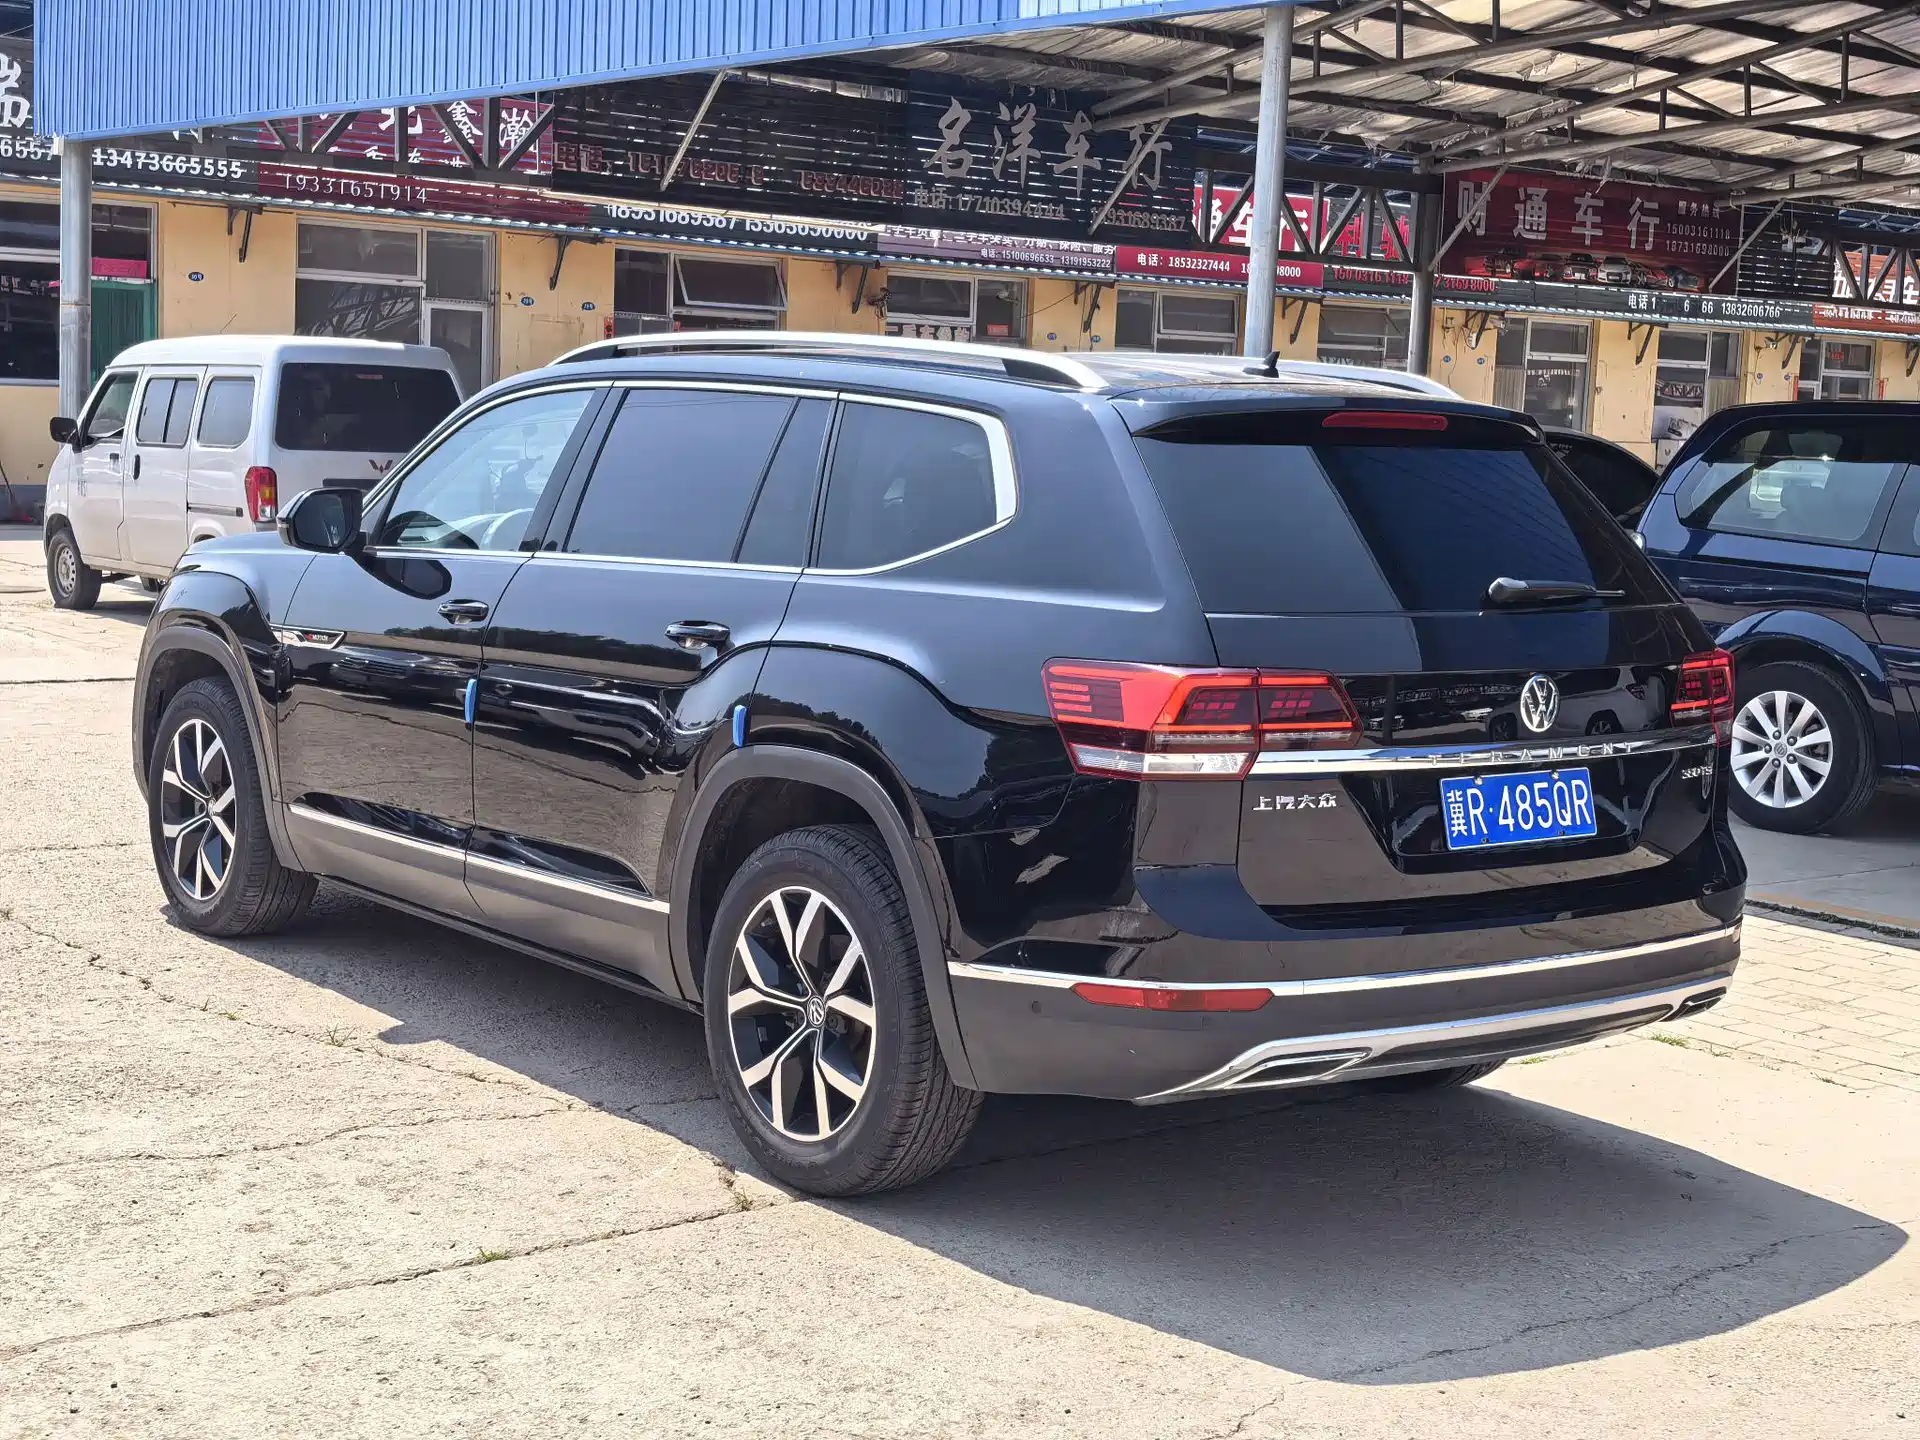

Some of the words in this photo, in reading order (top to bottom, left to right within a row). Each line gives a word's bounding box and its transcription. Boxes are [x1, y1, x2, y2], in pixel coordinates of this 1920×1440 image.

[92, 147, 244, 179] 13473665555
[284, 173, 427, 204] 19331651914
[1457, 180, 1660, 251] 财通车行
[1168, 256, 1231, 273] 18532327444
[1628, 293, 1649, 310] 电话
[1721, 302, 1781, 319] 13832606766
